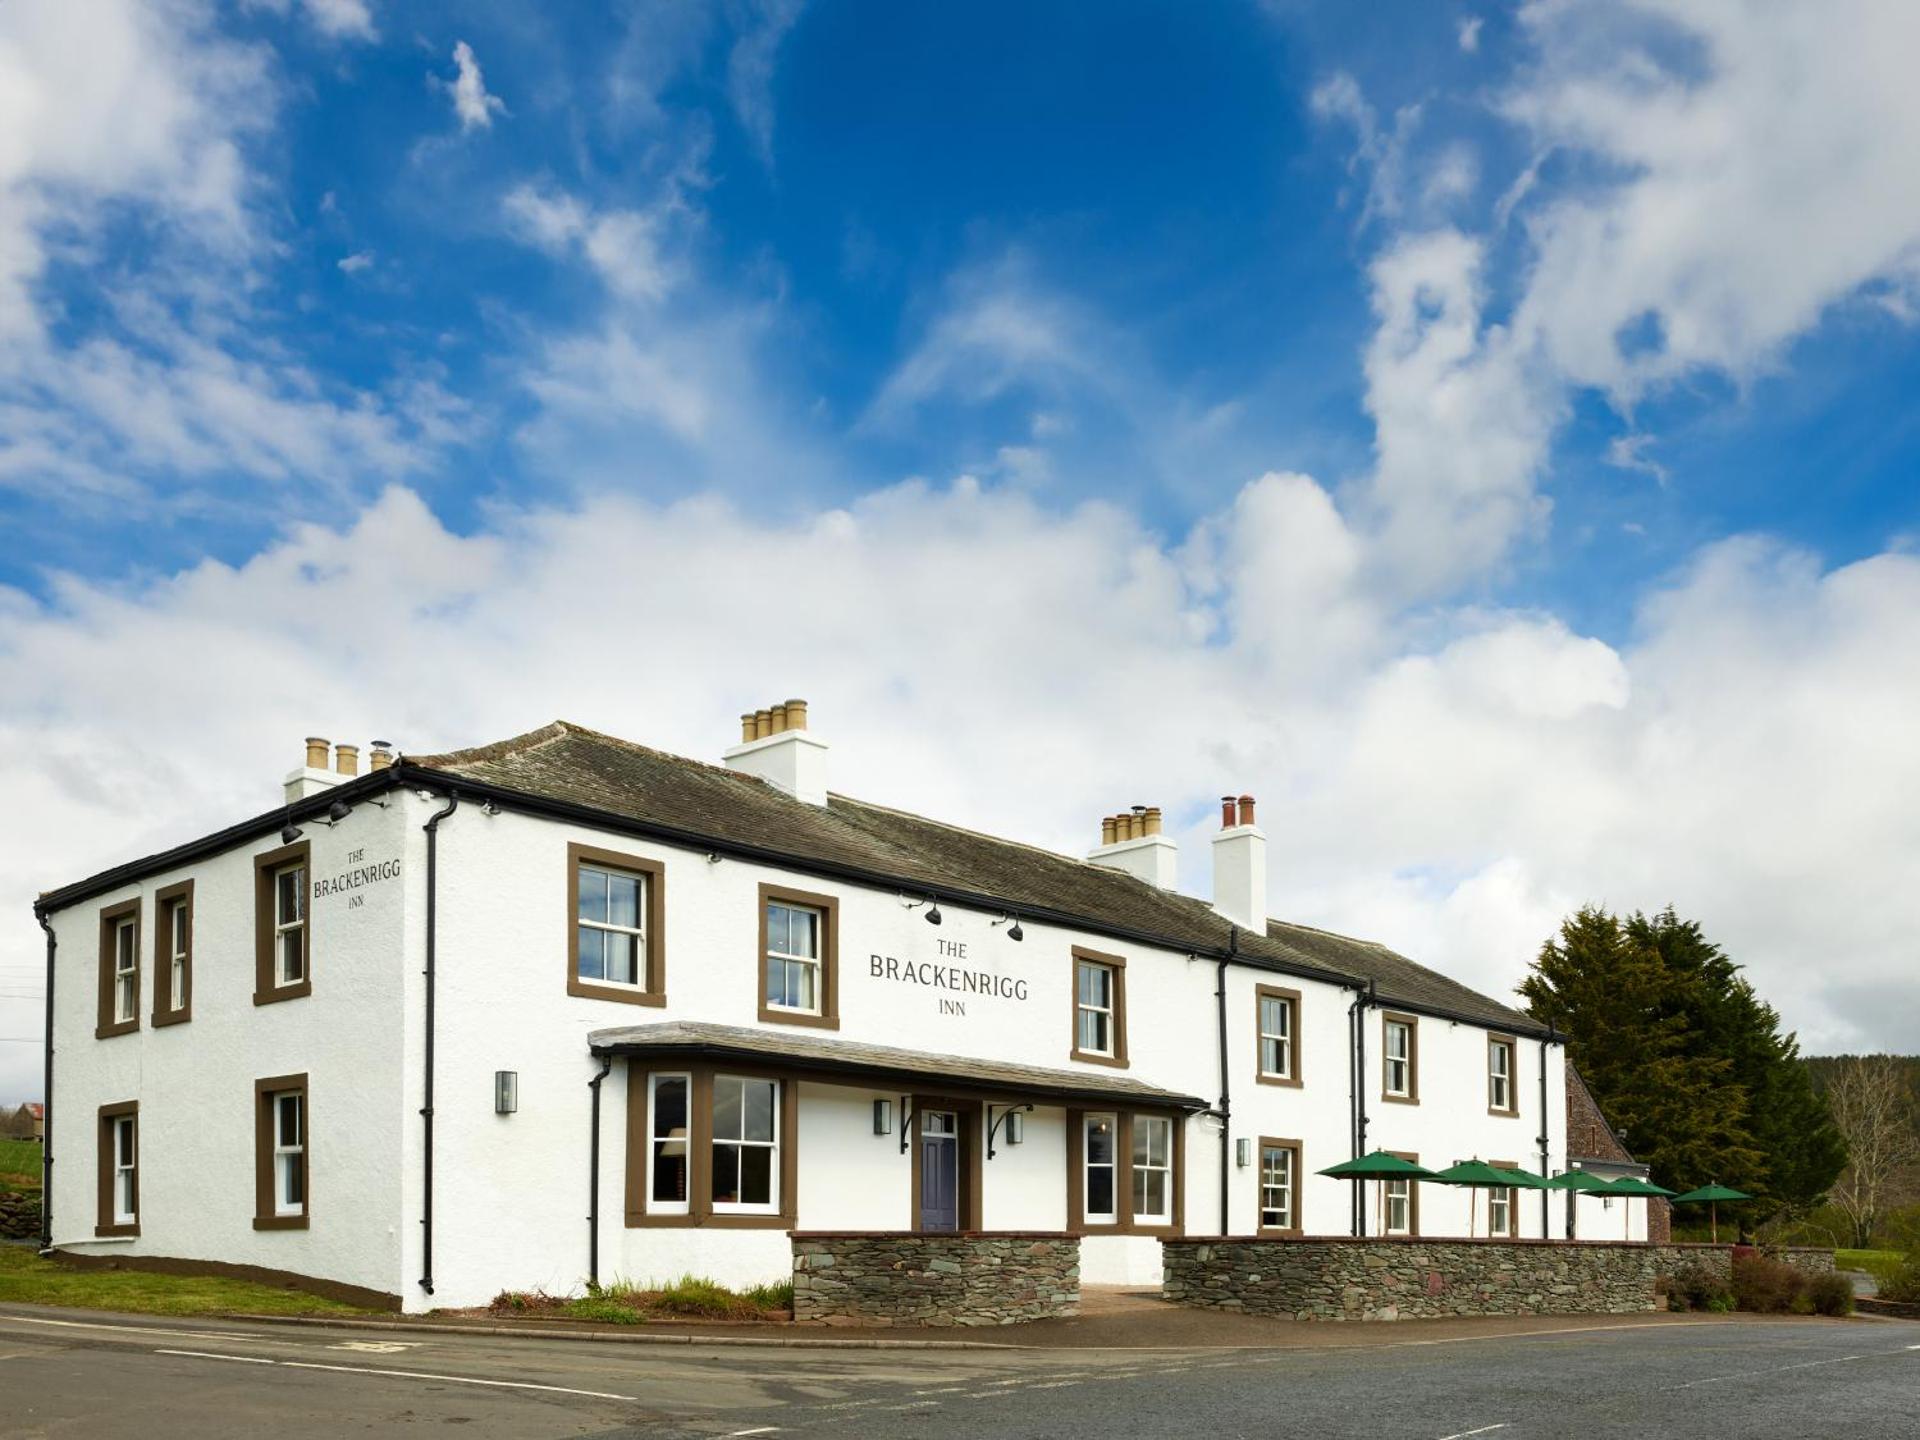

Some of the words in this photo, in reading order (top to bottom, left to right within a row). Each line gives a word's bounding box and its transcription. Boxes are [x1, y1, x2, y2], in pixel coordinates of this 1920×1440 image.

[347, 848, 364, 864] THE
[314, 859, 400, 898] BRACKENRIGG
[348, 894, 364, 909] INN
[937, 939, 967, 959] THE
[870, 954, 1027, 1001] BRACKENRIGG
[939, 999, 966, 1016] INN
